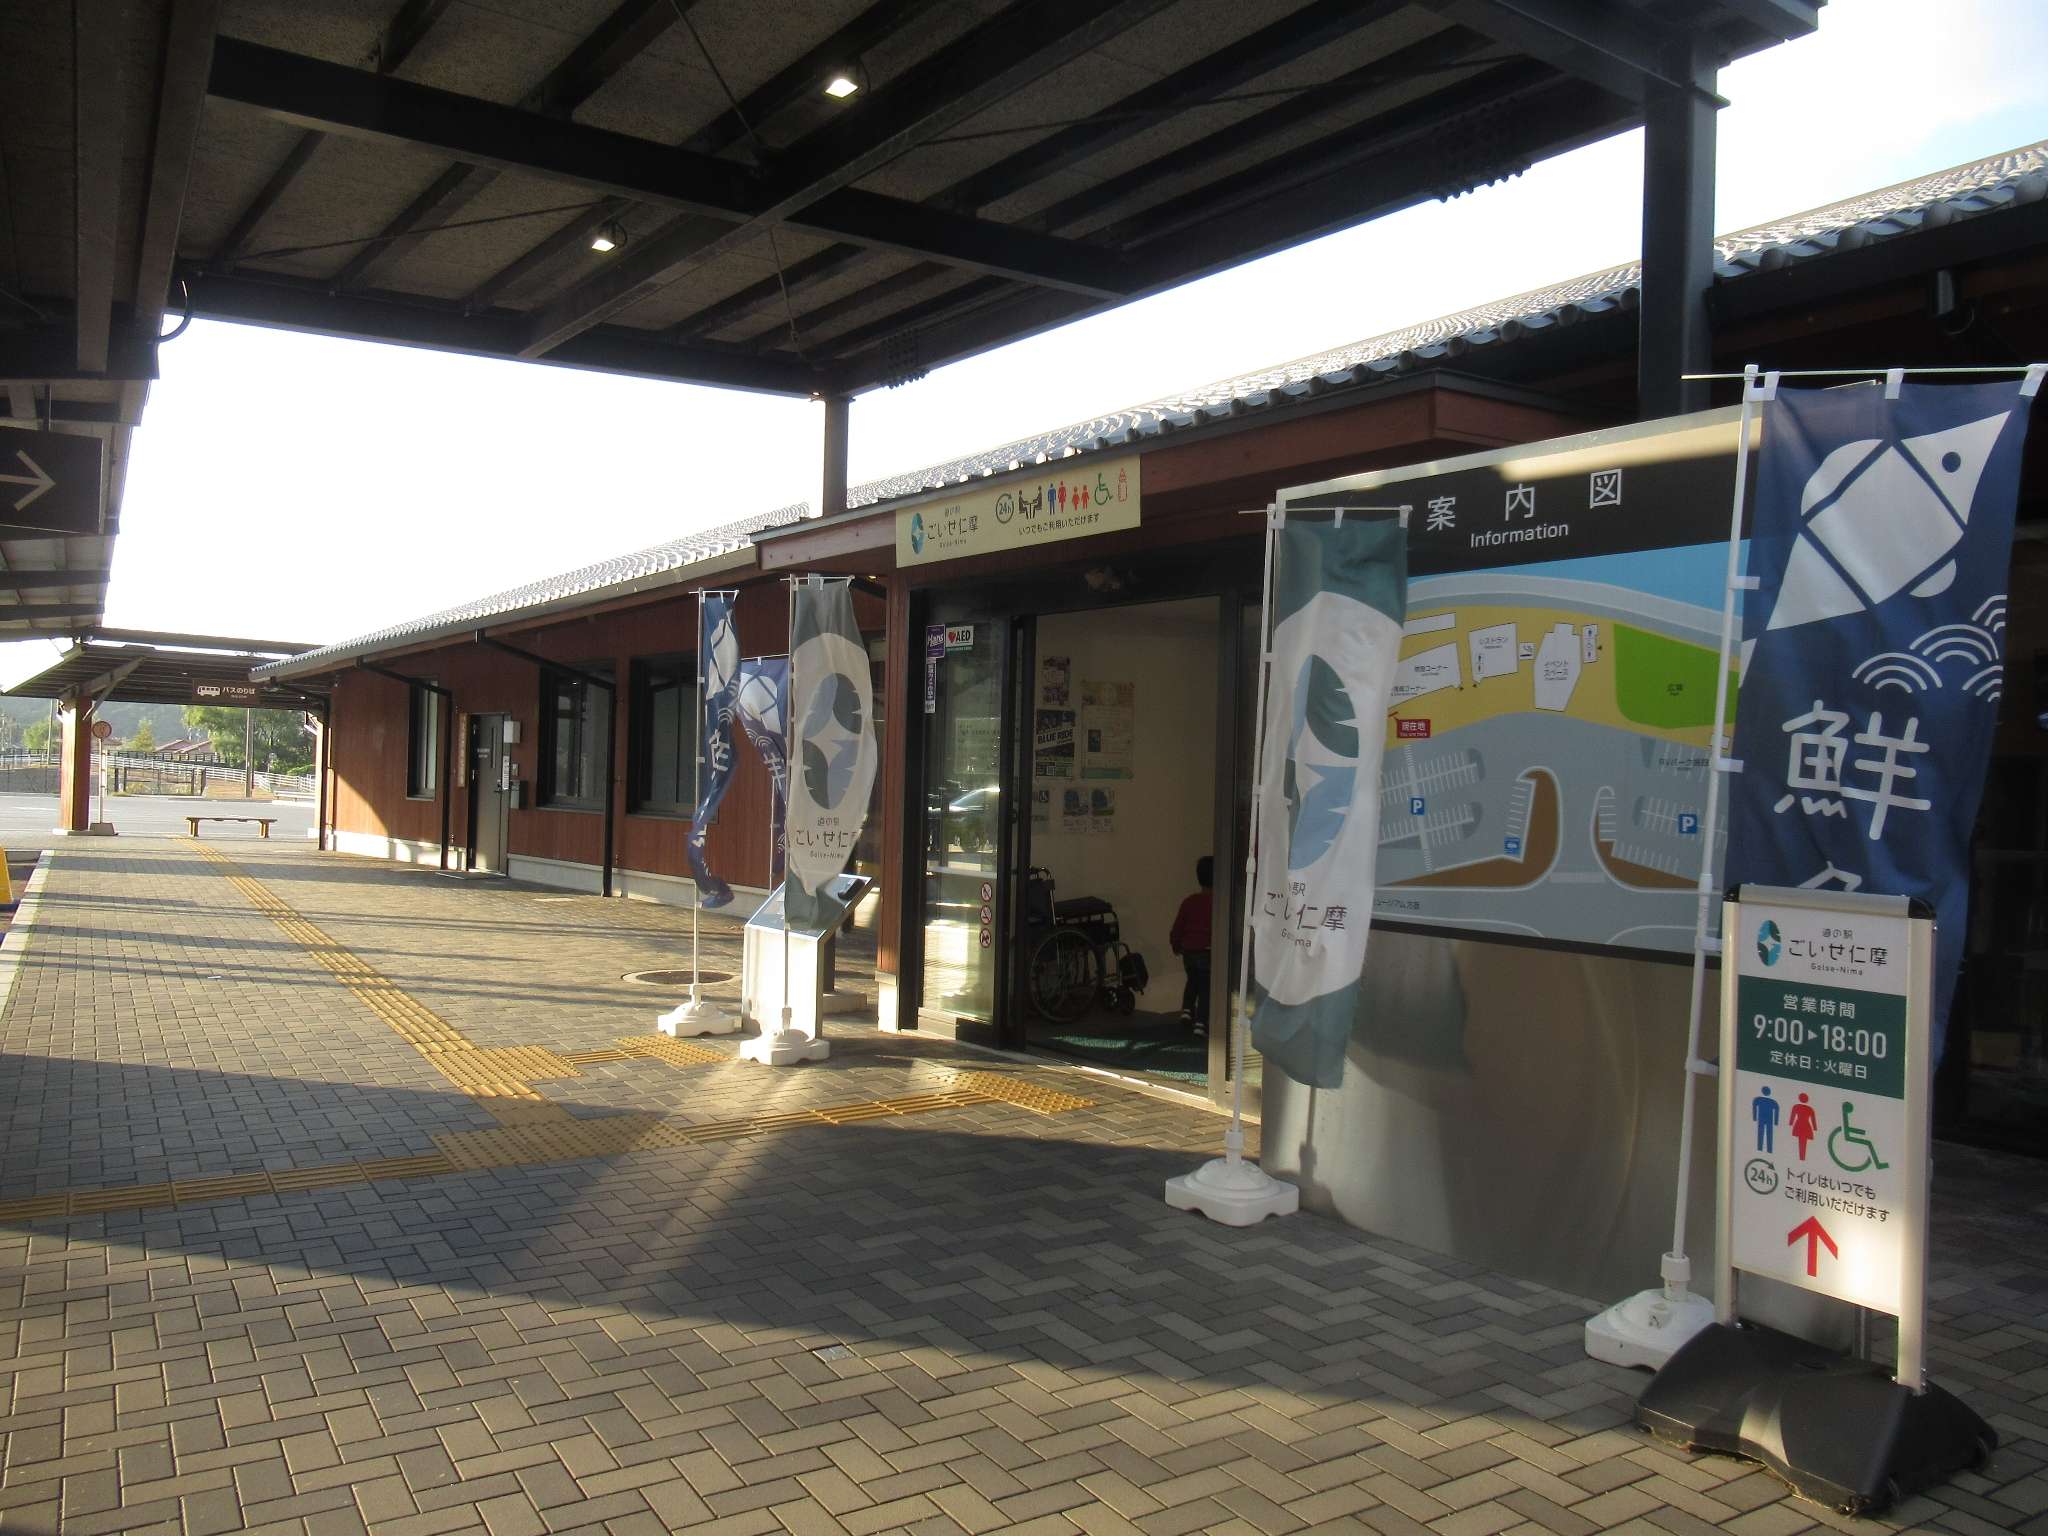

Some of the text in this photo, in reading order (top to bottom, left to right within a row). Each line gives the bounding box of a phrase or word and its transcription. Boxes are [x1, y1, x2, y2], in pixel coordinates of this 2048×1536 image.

[1426, 468, 1622, 531] 案内図
[1470, 522, 1569, 548] Information
[955, 630, 971, 642] AED
[222, 686, 256, 695] バスのりば
[1774, 700, 1931, 892] 鮮
[1822, 928, 1854, 940] 道の駅
[1788, 939, 1888, 967] ごいせ仁摩
[1810, 962, 1864, 976] Goise-Nima
[1783, 994, 1856, 1019] 営業時間
[1753, 1014, 1887, 1058] 9:00 18:00
[1750, 1167, 1773, 1185] 24h
[1786, 1168, 1876, 1200] トイレはいつでも
[1784, 1186, 1890, 1222] ご利用いただけます
